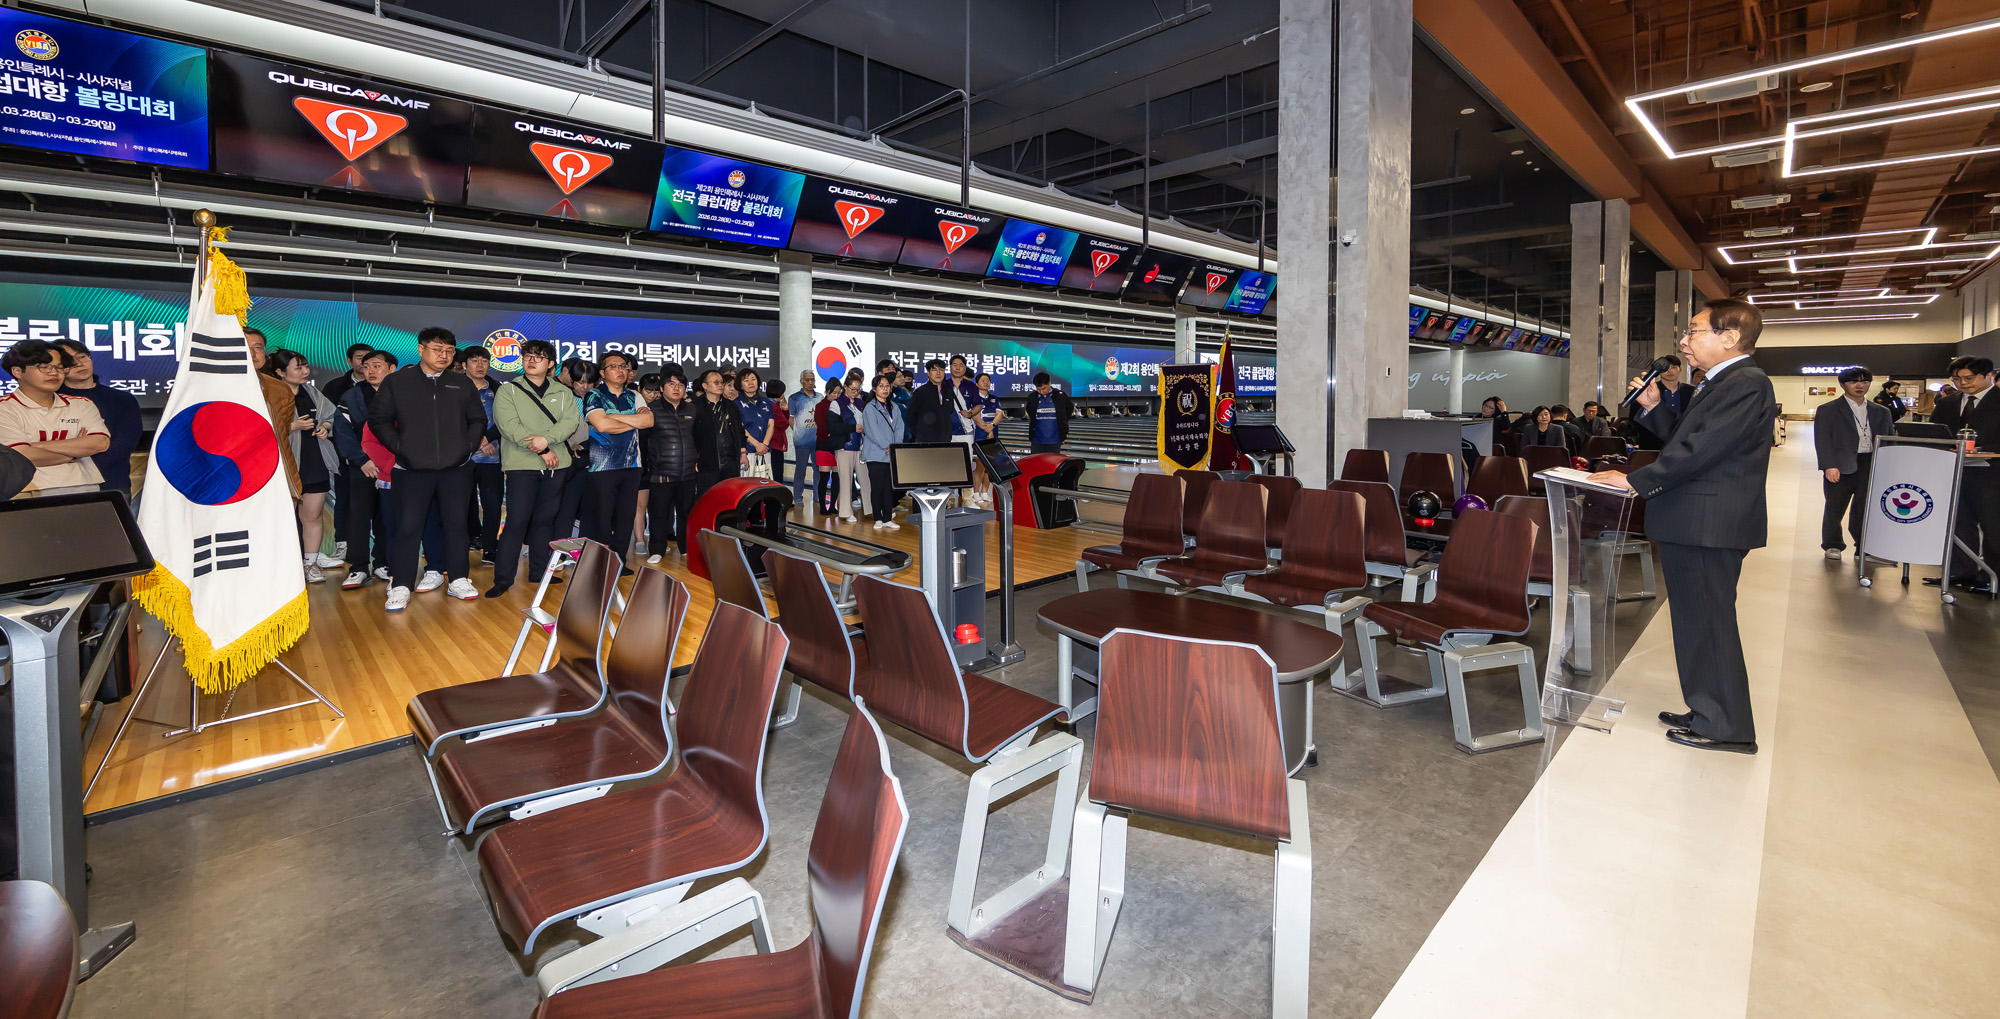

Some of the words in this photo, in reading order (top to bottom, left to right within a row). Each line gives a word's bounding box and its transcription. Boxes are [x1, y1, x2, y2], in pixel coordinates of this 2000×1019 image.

[25, 40, 49, 50] YIBA
[76, 72, 132, 92] 시사저널
[75, 85, 176, 120] 볼링대회
[672, 188, 696, 204] 전국
[698, 193, 742, 212] 클럽대항
[742, 201, 784, 219] 볼링대회
[494, 345, 520, 356] YIBA
[704, 346, 770, 368] 시사저널
[888, 350, 920, 372] 전국
[922, 352, 979, 374] 클럽항
[982, 354, 1030, 375] 볼링대회
[1120, 362, 1139, 376] 제2회
[1141, 363, 1161, 376] 용인특
[1802, 366, 1834, 374] SNACK
[1238, 366, 1251, 380] 전국
[1252, 366, 1275, 380] 클럽대항
[1182, 393, 1192, 408] 祝
